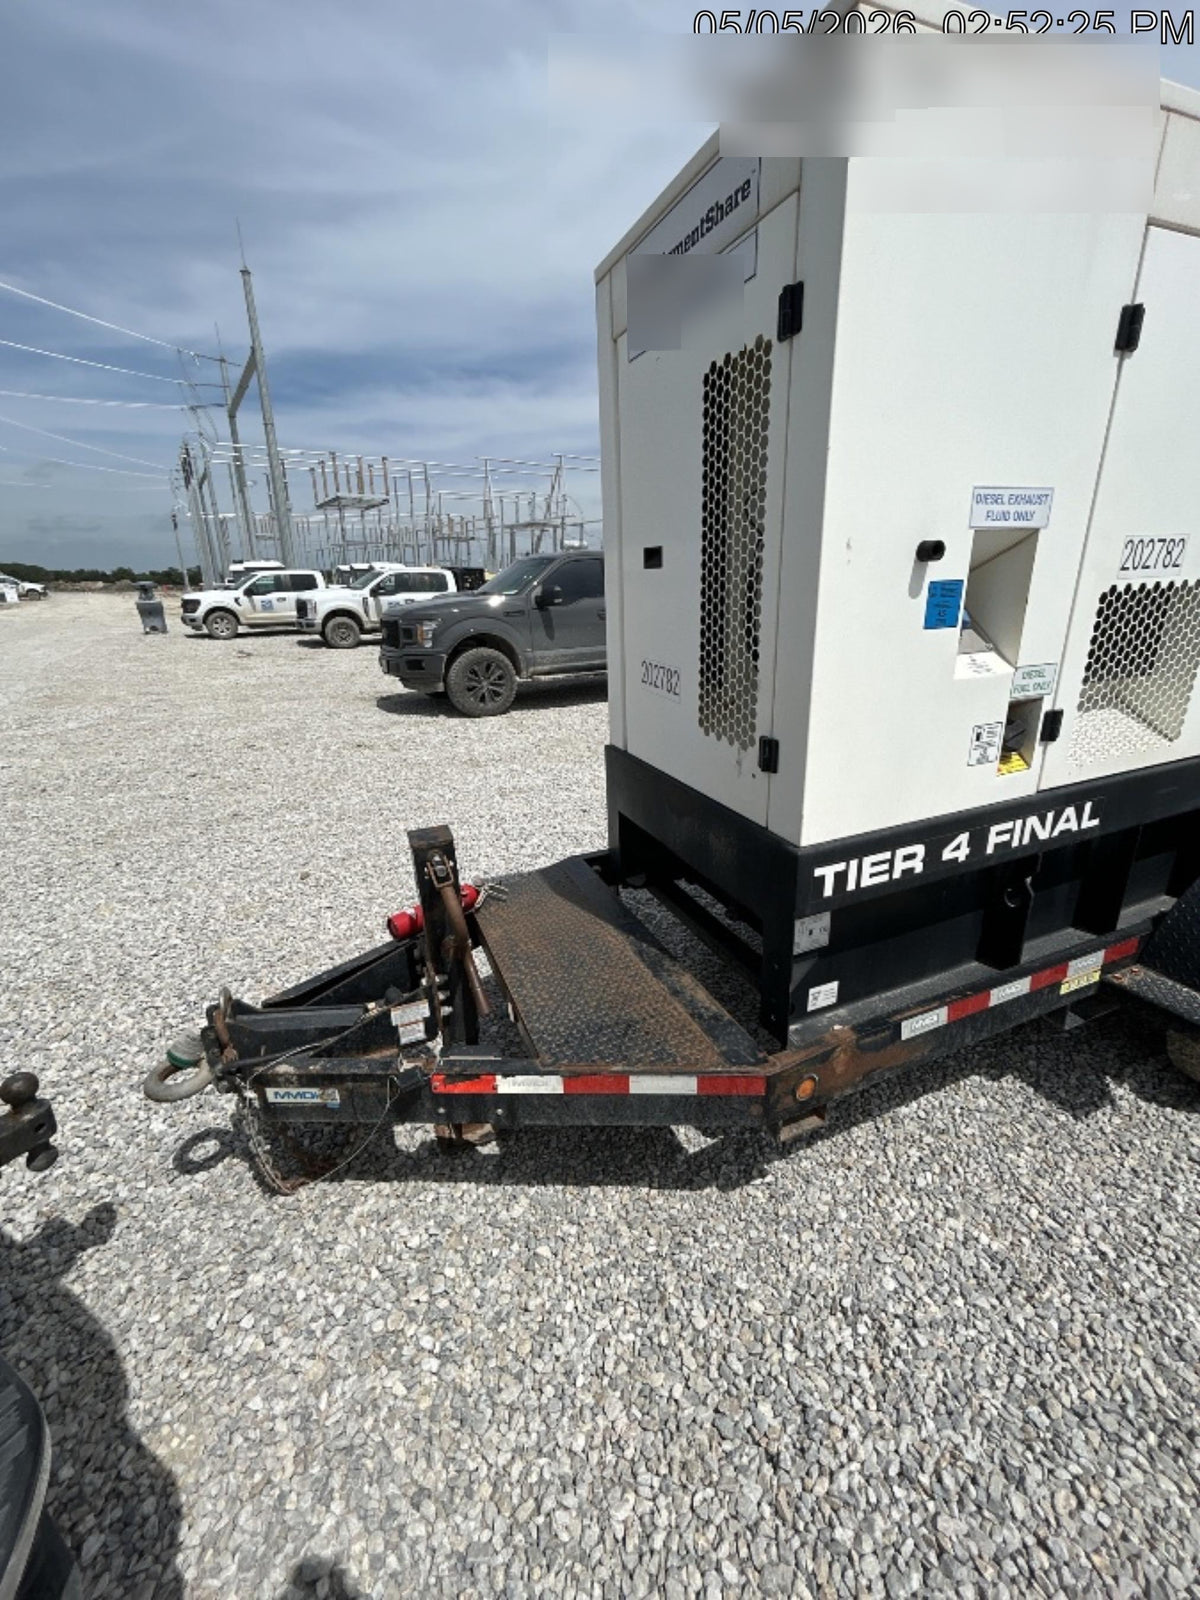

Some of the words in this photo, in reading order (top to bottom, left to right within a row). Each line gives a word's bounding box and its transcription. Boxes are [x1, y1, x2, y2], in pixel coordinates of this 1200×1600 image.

[975, 495, 1005, 507] DIESEL
[1008, 494, 1051, 506] EXHAUST
[985, 510, 1011, 522] FLUID
[1013, 510, 1036, 521] ONLY
[1120, 538, 1186, 571] 202782
[813, 844, 925, 898] TIER
[941, 832, 970, 863] 4
[986, 801, 1100, 855] FINAL
